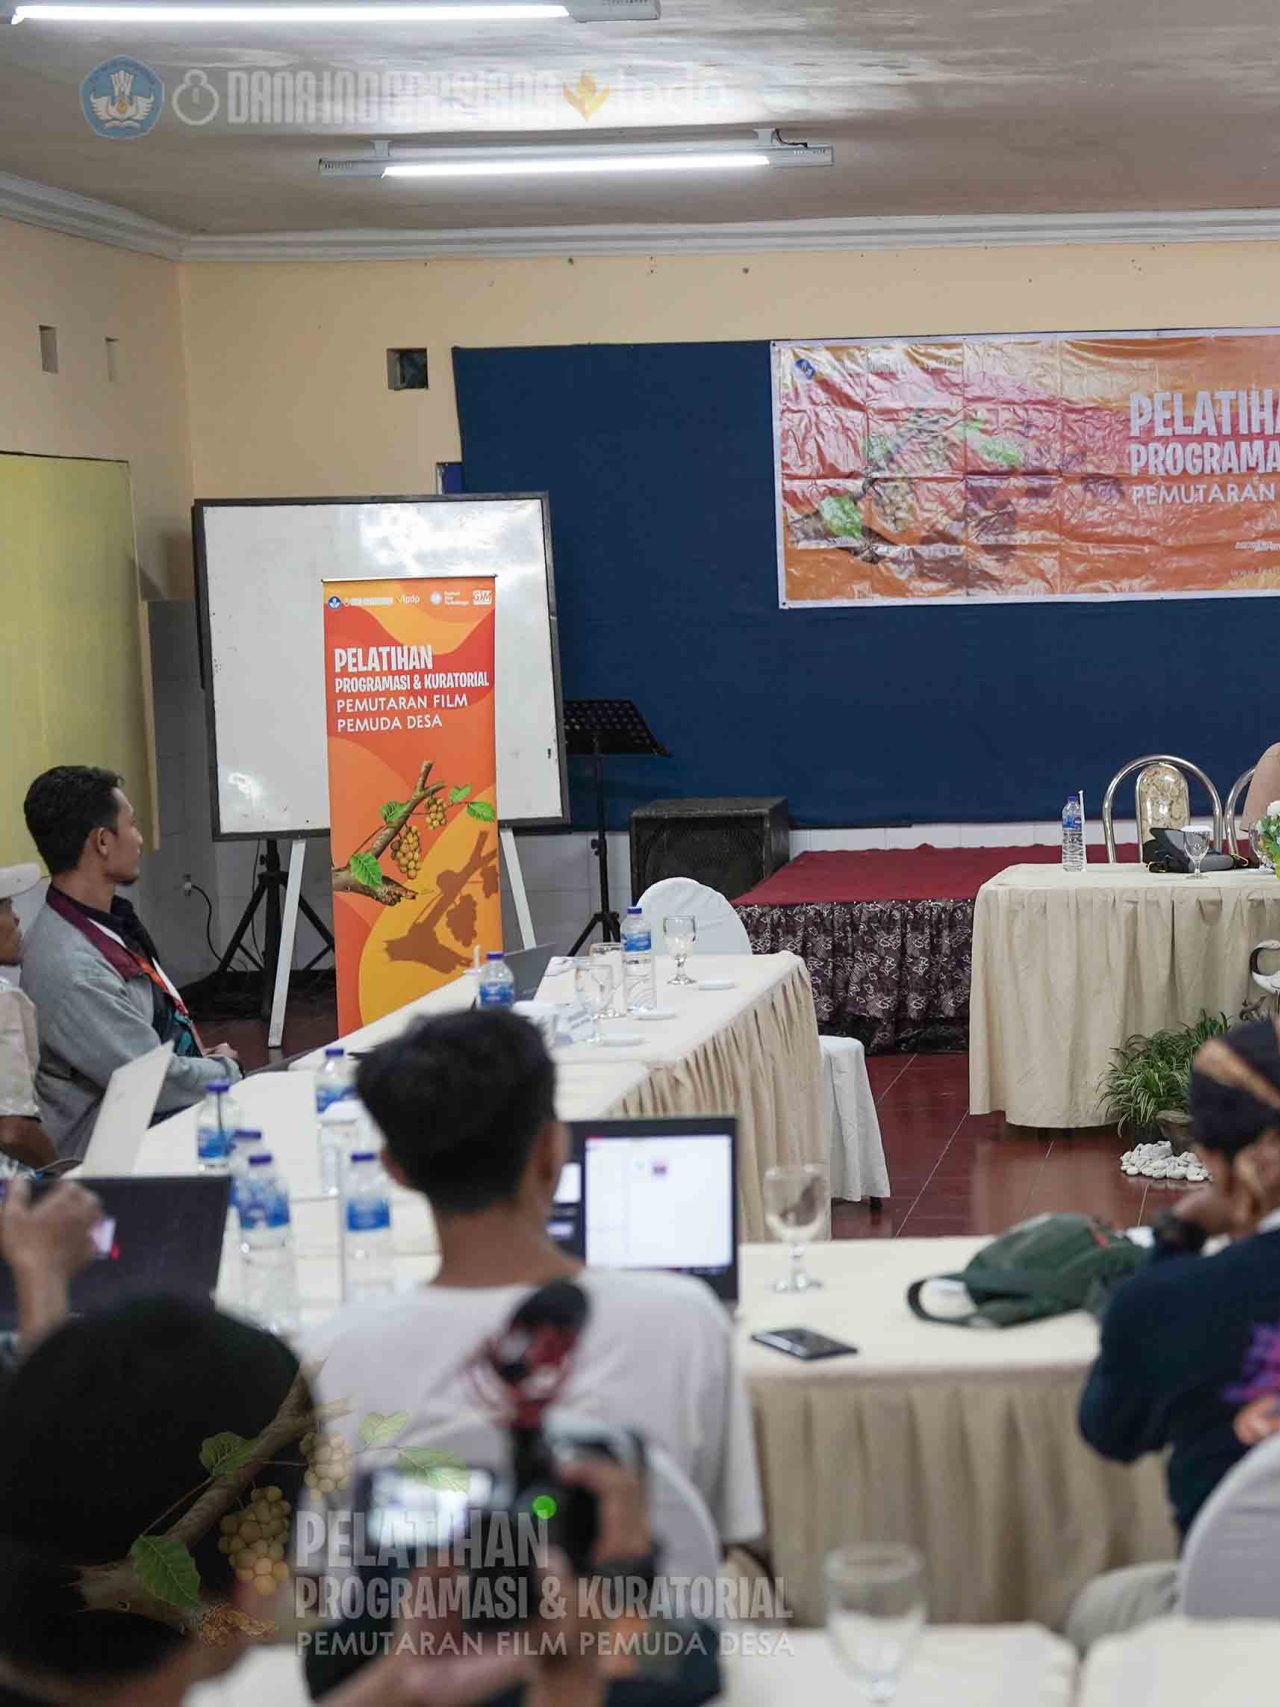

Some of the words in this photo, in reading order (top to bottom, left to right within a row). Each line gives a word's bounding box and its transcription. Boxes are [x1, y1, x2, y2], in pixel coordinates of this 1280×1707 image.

[1132, 482, 1275, 505] PEMUTARAN
[334, 645, 433, 673] PELATIHAN
[335, 674, 410, 693] PROGRAMASI
[413, 674, 422, 690] &
[424, 672, 489, 689] KURATORIAL
[336, 695, 428, 713] PEMUTARAN
[433, 693, 468, 708] FILM
[337, 716, 402, 732] PEMUDA
[407, 714, 443, 729] DESA
